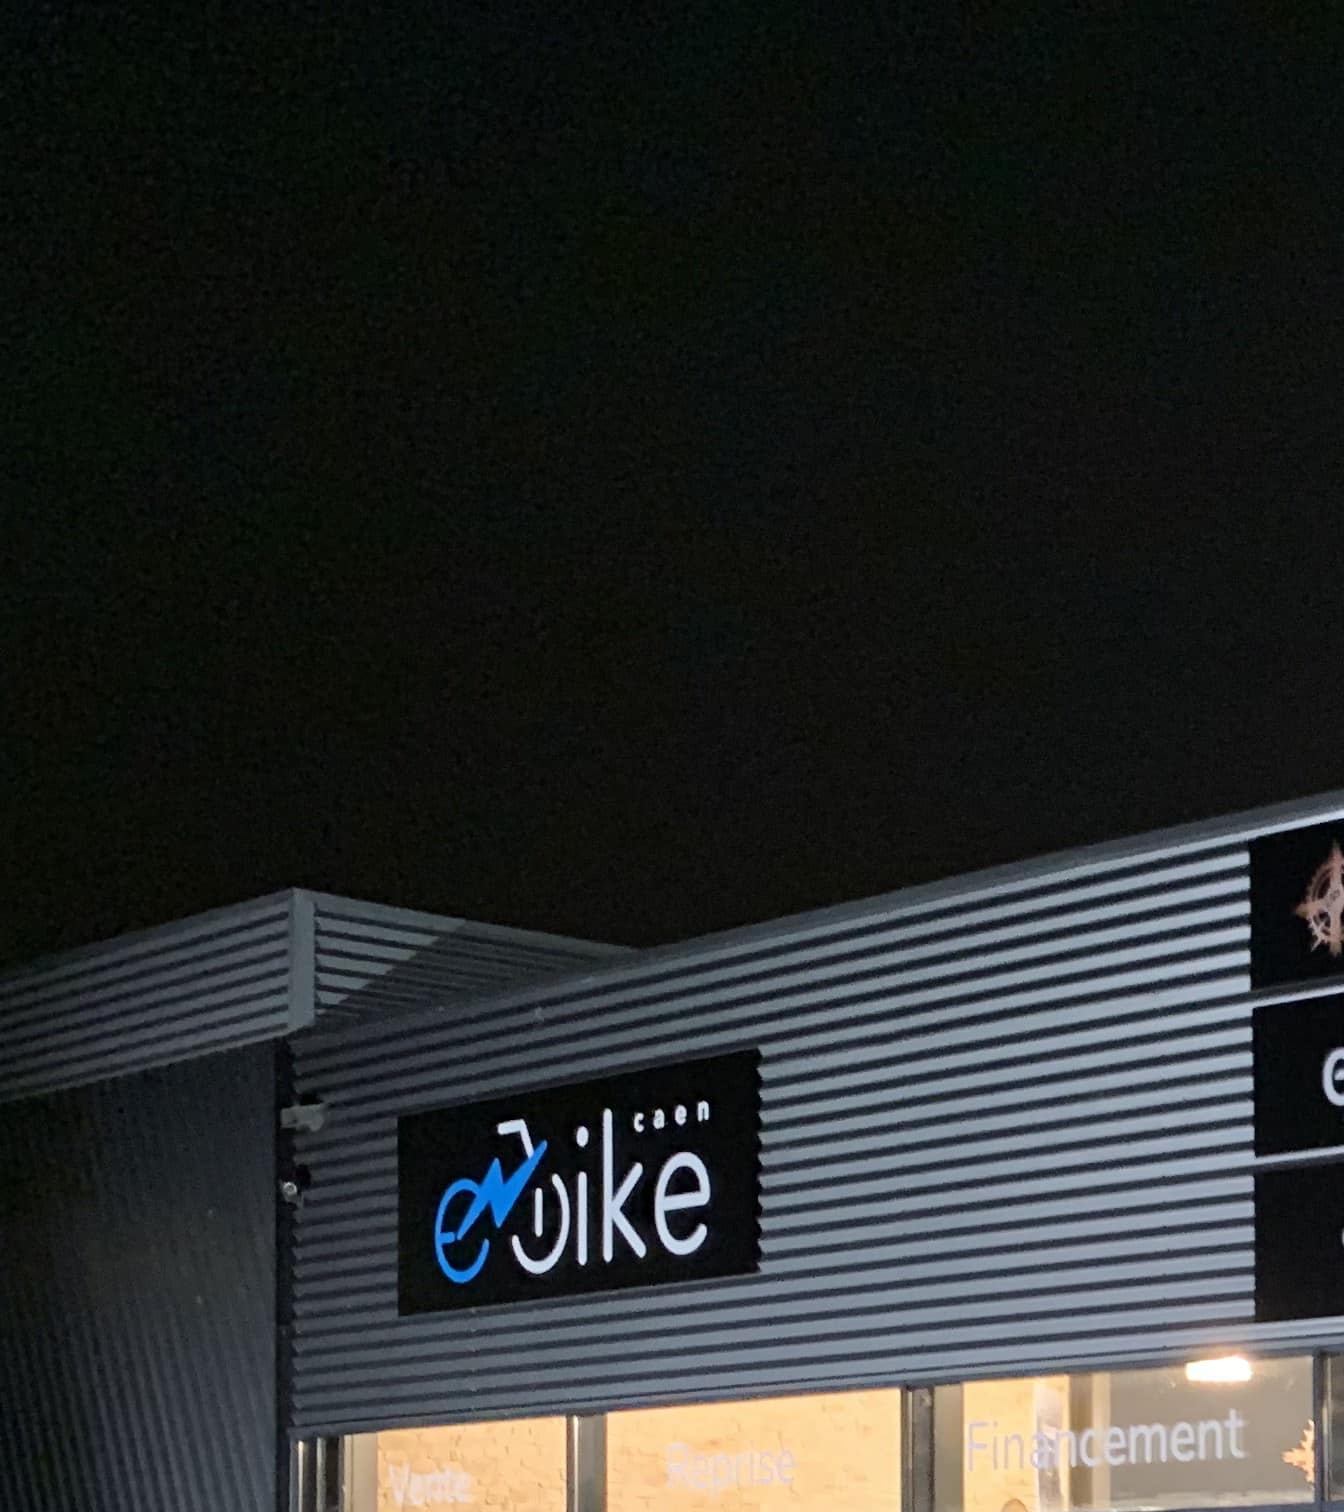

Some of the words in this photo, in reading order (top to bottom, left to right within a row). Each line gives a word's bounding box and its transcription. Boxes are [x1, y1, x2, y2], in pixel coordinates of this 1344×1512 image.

[634, 1100, 710, 1132] caen
[967, 1408, 1248, 1473] Financement
[666, 1441, 797, 1500] Reprise
